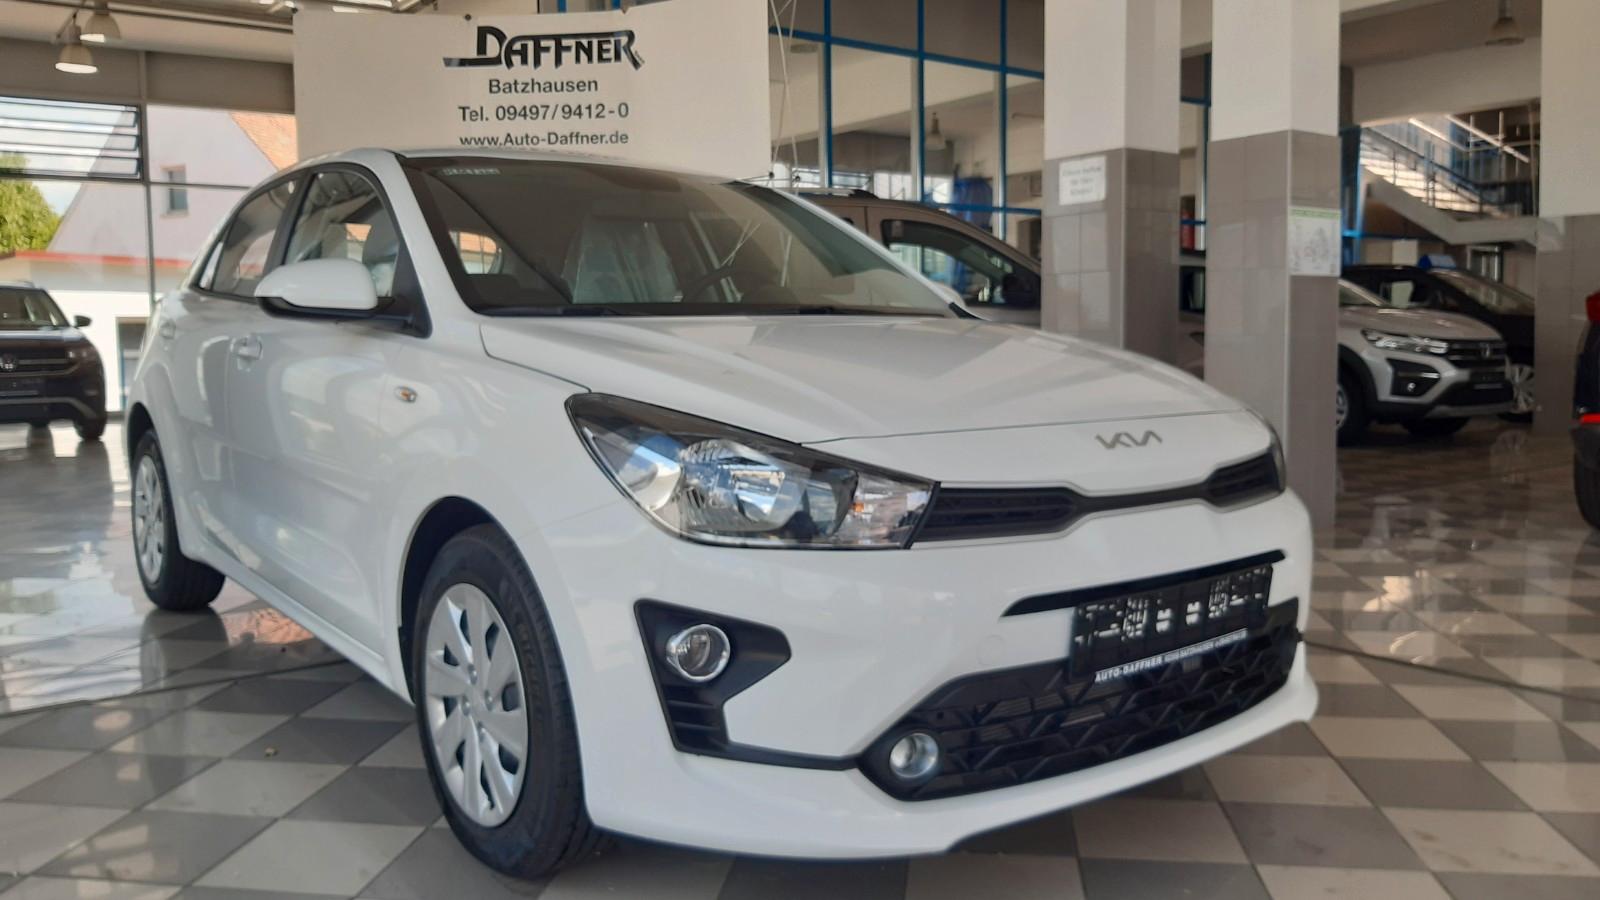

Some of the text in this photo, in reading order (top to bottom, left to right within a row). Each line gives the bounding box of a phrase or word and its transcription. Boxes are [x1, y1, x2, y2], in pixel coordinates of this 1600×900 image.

[443, 26, 643, 70] DAFFNER
[489, 79, 598, 95] Batzhausen
[459, 106, 489, 121] Tel.
[459, 131, 629, 147] www.Auto-Daffner.de
[1095, 430, 1163, 449] KIA
[1094, 656, 1163, 683] AUTO-DAFFNER
